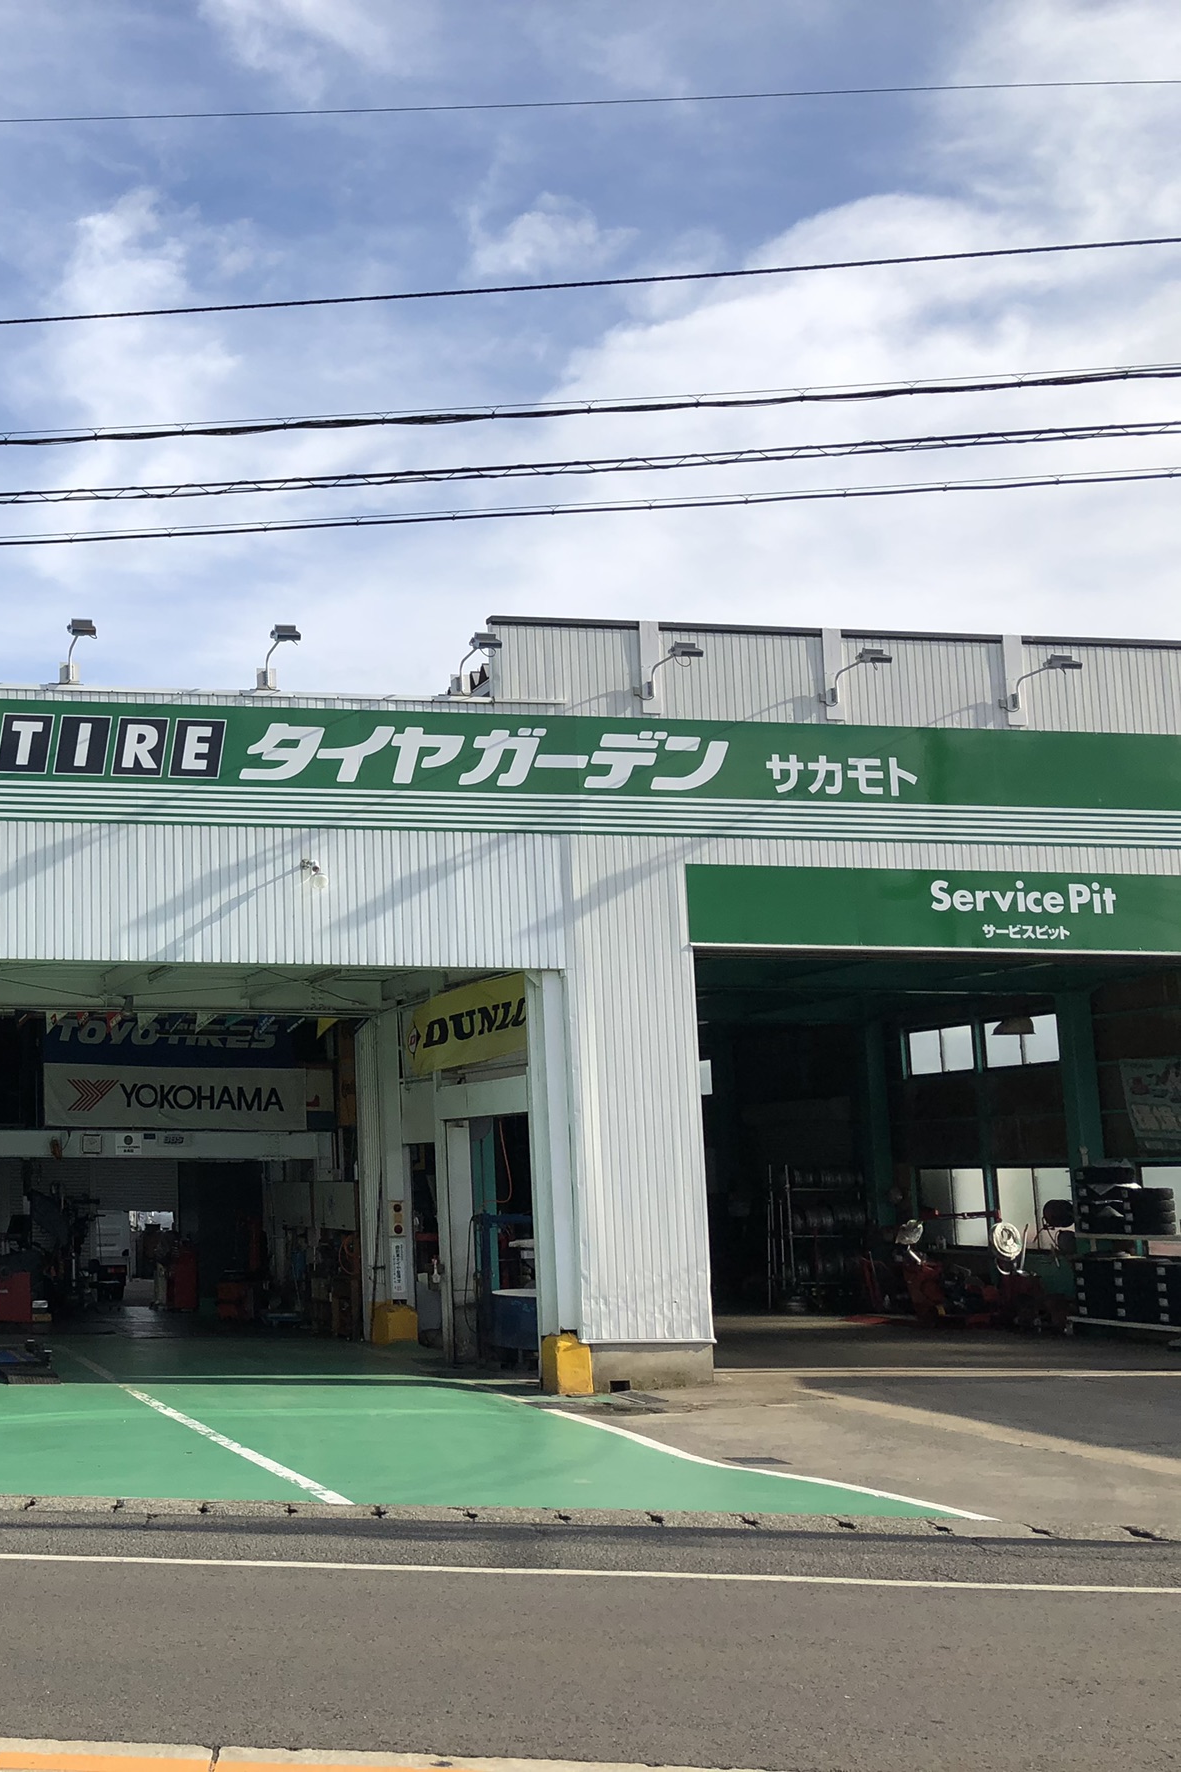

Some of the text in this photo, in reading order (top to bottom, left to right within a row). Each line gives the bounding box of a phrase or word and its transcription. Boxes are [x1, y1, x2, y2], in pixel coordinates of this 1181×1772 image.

[11, 720, 213, 770] TIRE
[238, 722, 919, 797] タイヤガーデン サカモト
[930, 879, 1117, 915] Service Pit
[982, 923, 1070, 940] サービスピット
[120, 1083, 285, 1112] YOKOHAMA
